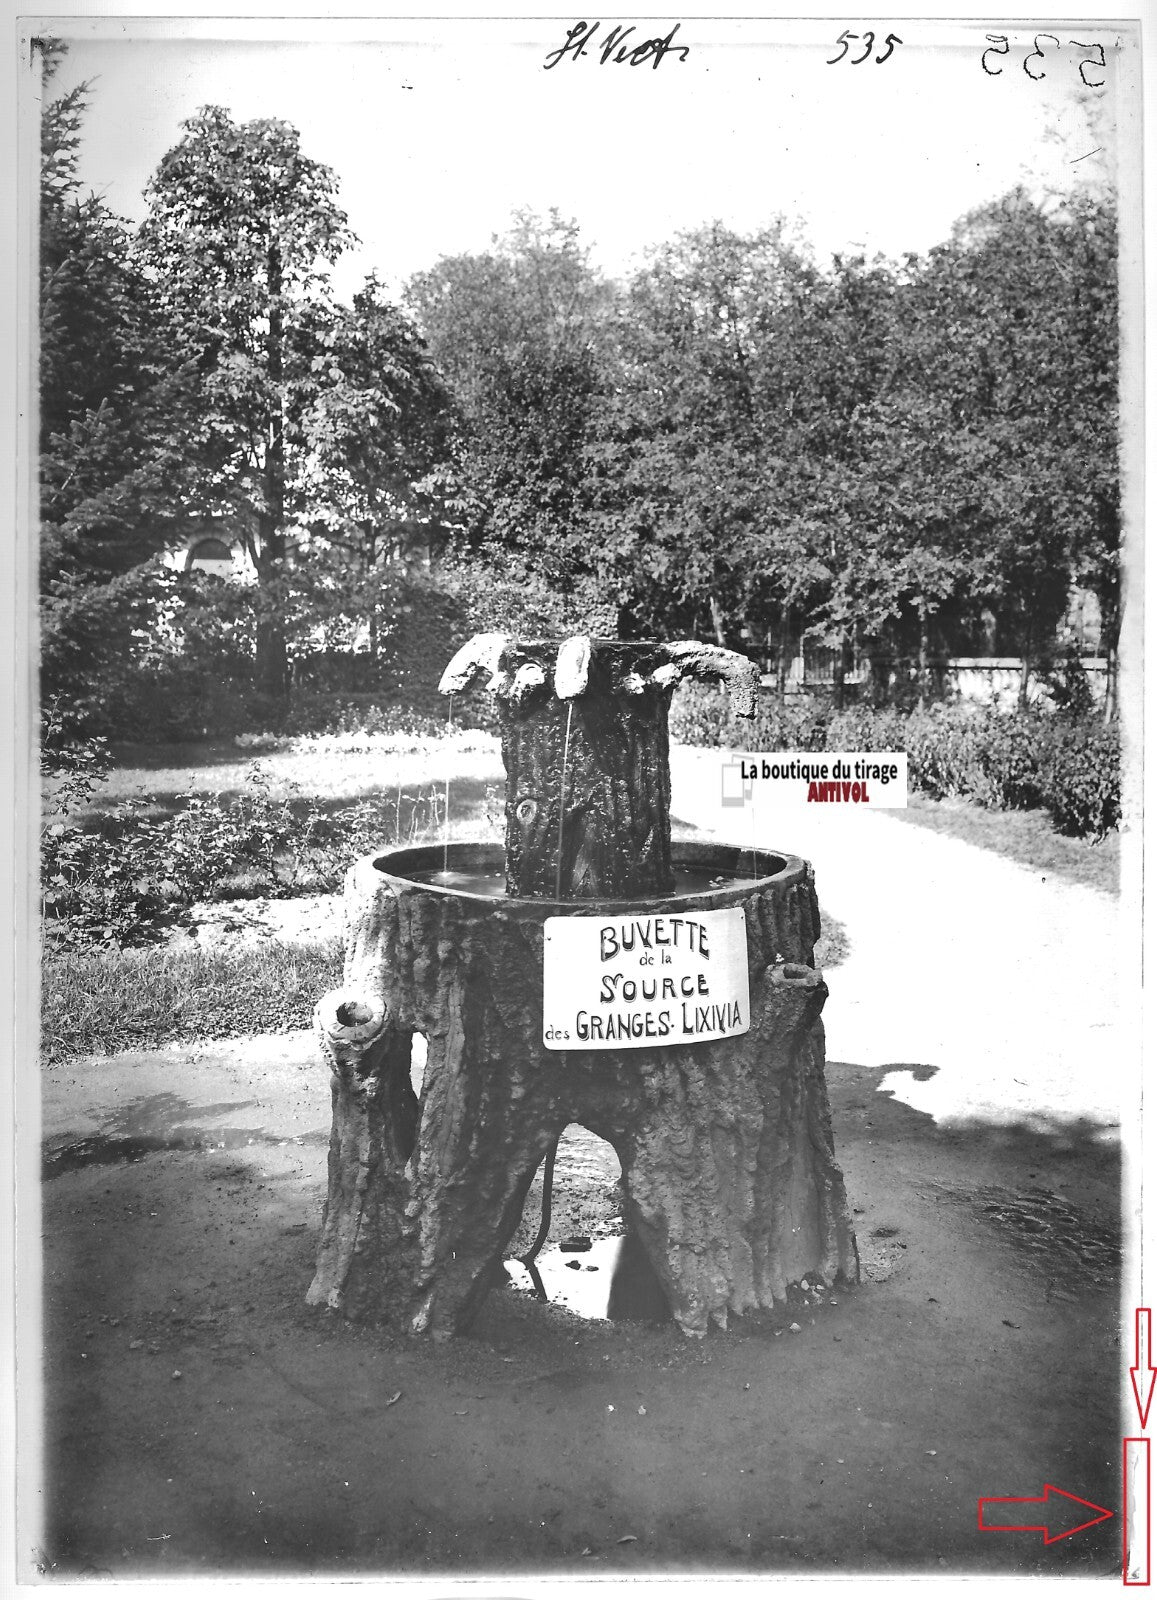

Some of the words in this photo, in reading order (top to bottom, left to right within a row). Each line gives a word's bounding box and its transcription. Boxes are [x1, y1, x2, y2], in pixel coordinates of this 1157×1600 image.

[826, 30, 904, 65] 535
[600, 918, 710, 962] BUVETTE
[639, 951, 655, 966] de
[661, 948, 672, 965] la
[600, 973, 710, 1003] SOURCE
[544, 1024, 571, 1041] des
[681, 1000, 744, 1035] LIXIVIA
